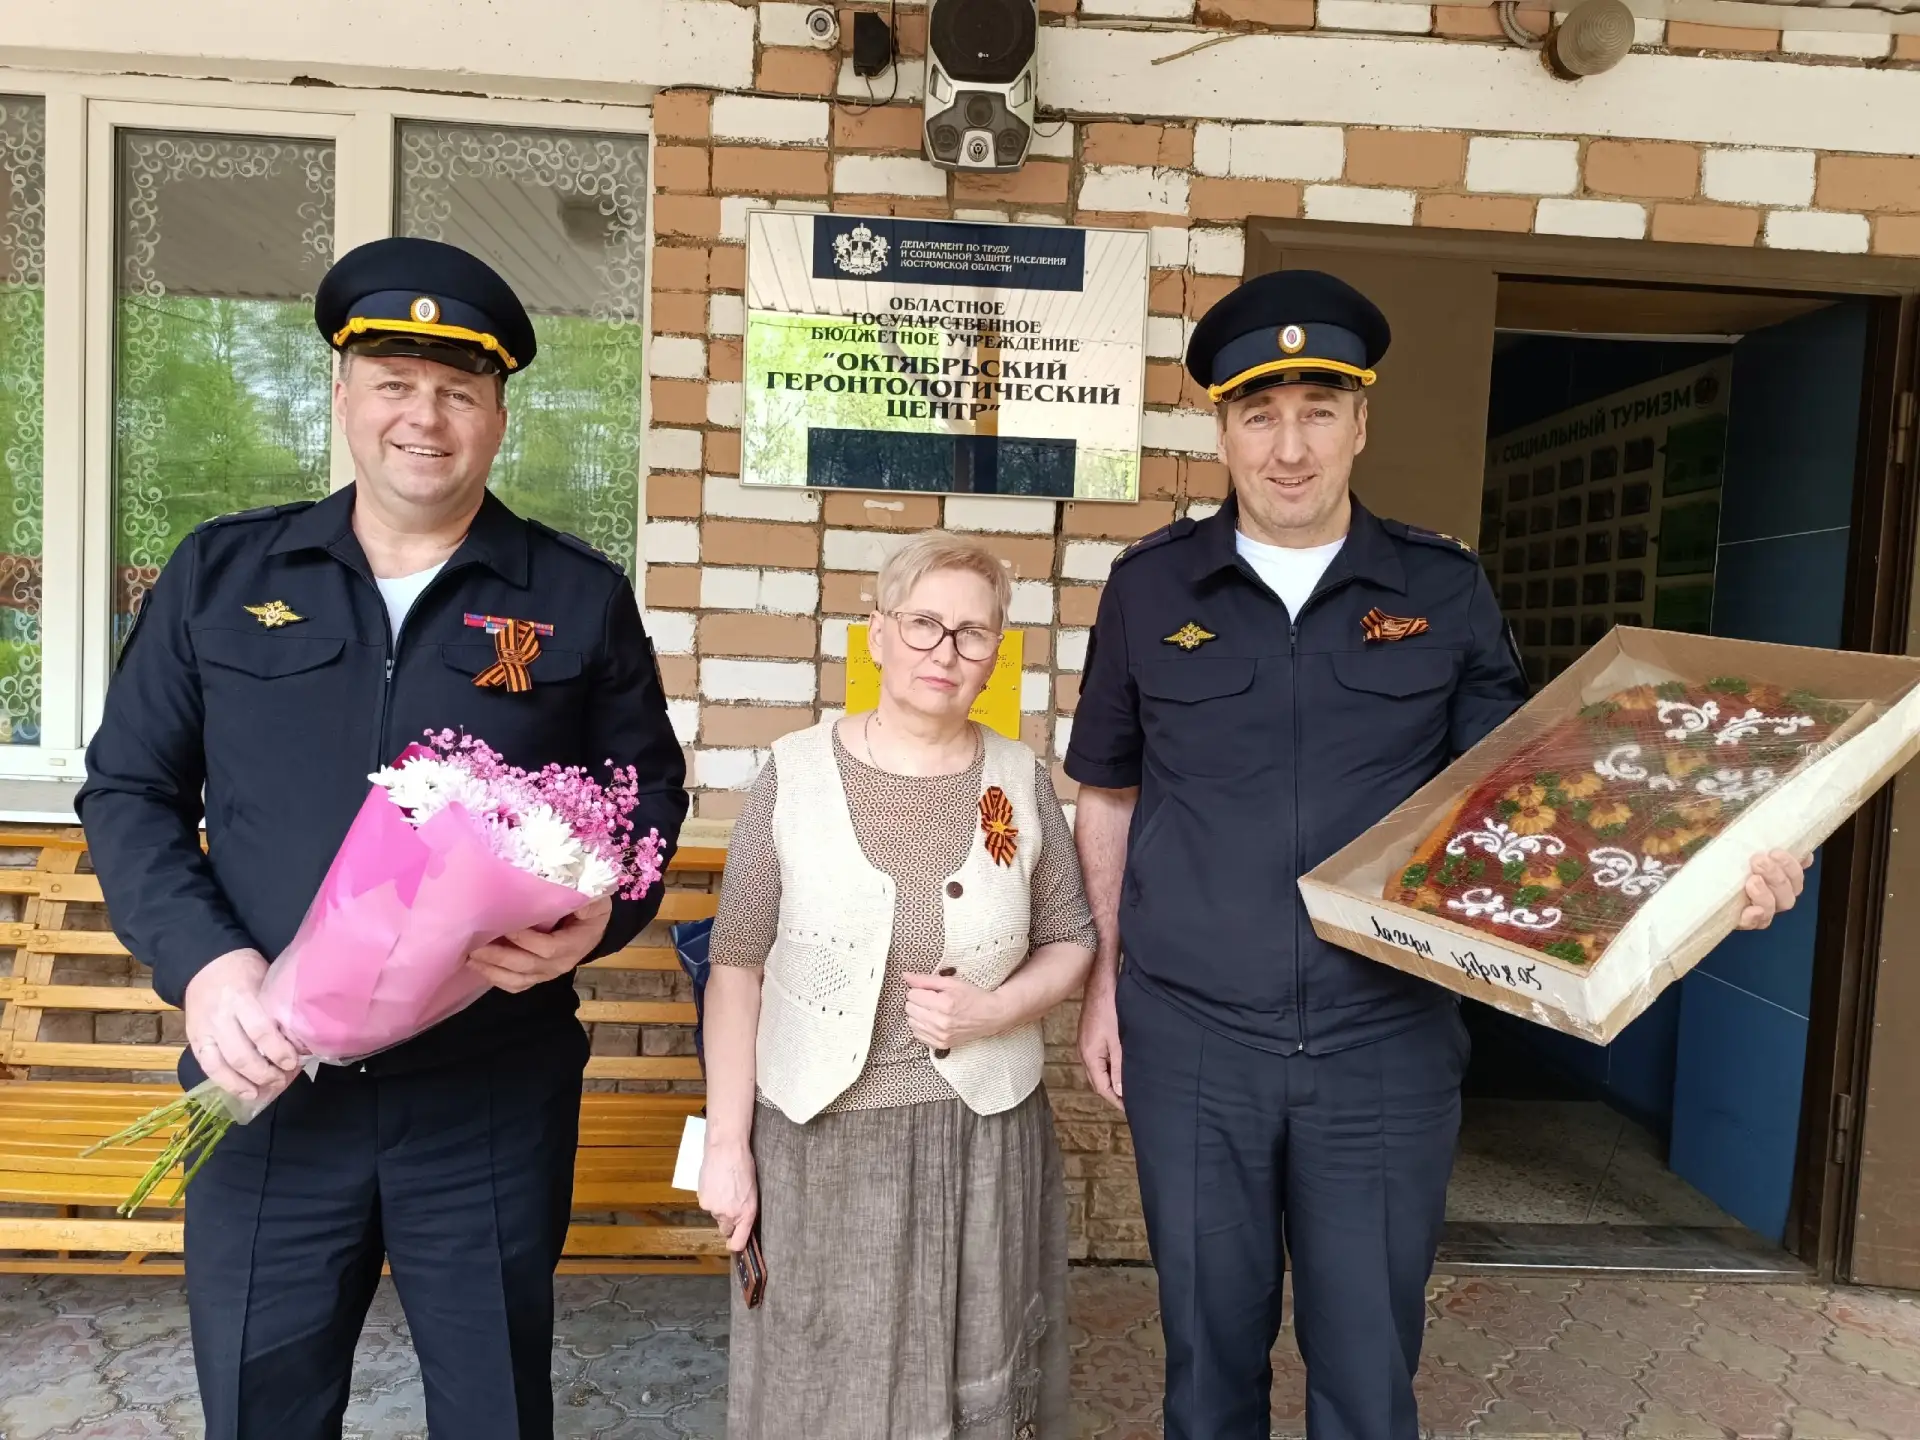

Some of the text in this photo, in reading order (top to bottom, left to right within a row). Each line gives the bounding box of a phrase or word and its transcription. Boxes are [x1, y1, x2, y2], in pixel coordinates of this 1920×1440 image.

[900, 240, 1010, 254] ДЕПАРТАМЕНТ ПО ТРУДУ
[901, 250, 1067, 266] И СОЦИАЛЬНОЙ ЗАЩИТЕ НАСЕЛЕНИЯ
[900, 259, 1013, 273] КОСТРОМСКОЙ ОБЛАСТИ
[889, 297, 1006, 316] ОБЛАСТНОЕ
[852, 312, 1042, 334] ГОСУДАРСТВЕННОЕ
[811, 327, 1080, 352] БЮДЖЕТНОЕ УЧРЕЖДЕНИЕ
[823, 352, 1067, 381] "ОКТЯБРЬСКИЙ
[766, 371, 1121, 405] ГЕРОНТОЛОГИЧЕСКИЙ
[886, 399, 1001, 421] ЦЕНТР"
[1502, 385, 1691, 463] СОЦИАЛЬНЫЙ ТУРИЗМ
